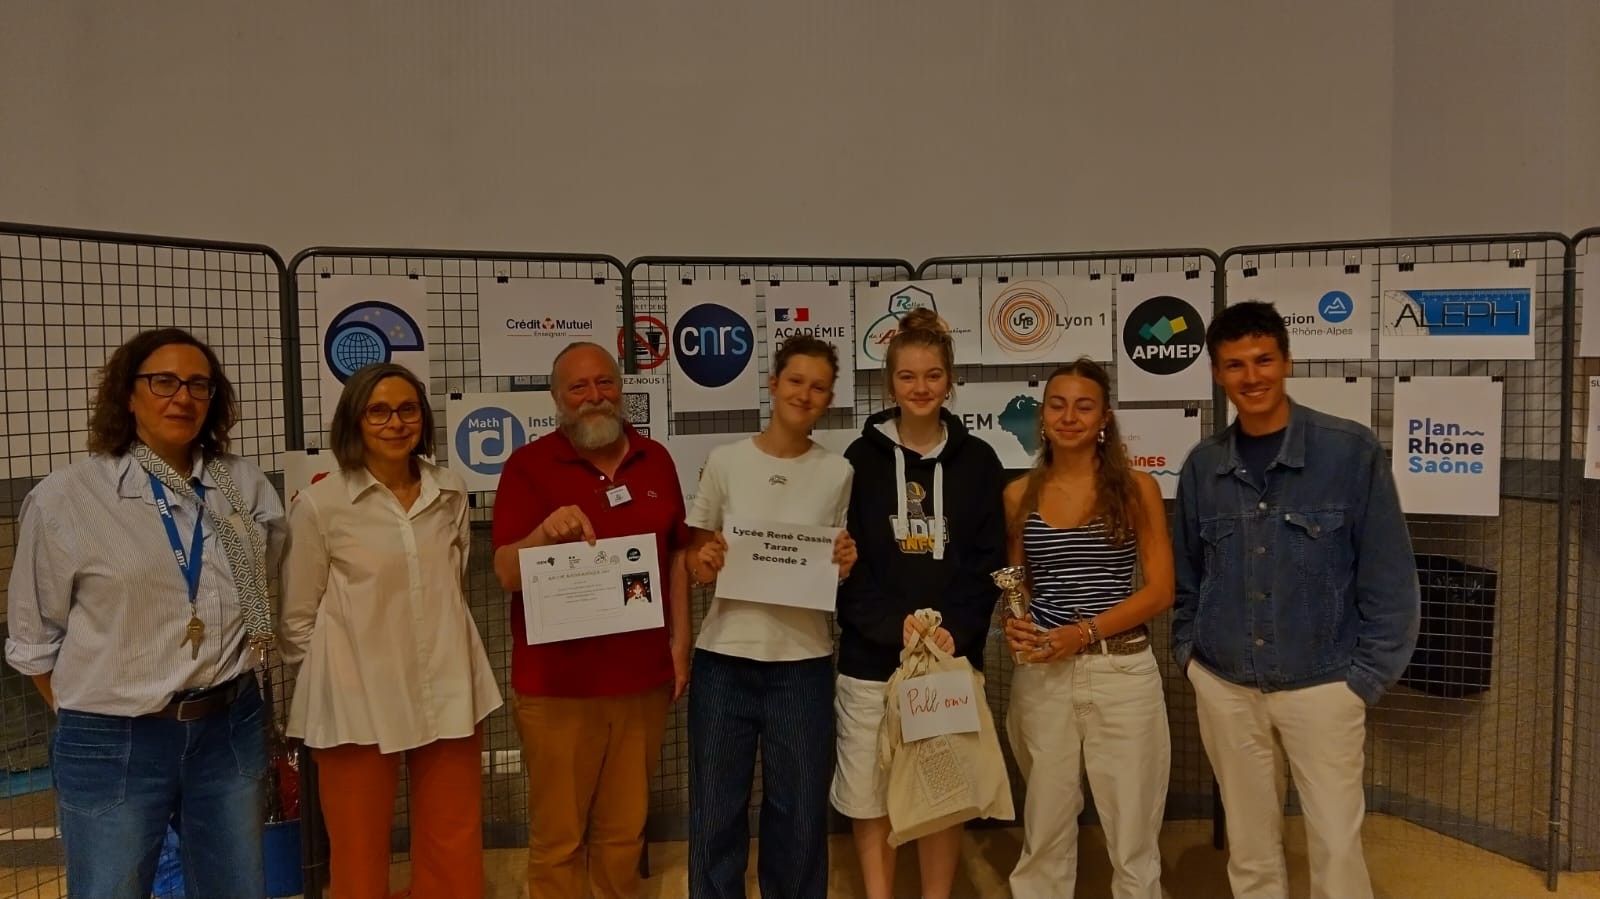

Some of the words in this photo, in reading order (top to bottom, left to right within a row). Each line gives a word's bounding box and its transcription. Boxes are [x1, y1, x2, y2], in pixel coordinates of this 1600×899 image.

[1055, 313, 1093, 330] Lyon
[1099, 313, 1105, 326] 1
[1283, 313, 1315, 326] gion
[1394, 301, 1521, 328] ALEPH
[506, 318, 541, 329] Crédit
[556, 319, 593, 329] Mutuel
[774, 324, 845, 338] ACADÉMIE
[1288, 327, 1353, 336] -Rhône-Alpes
[680, 326, 748, 356] cnrs
[1132, 344, 1201, 360] APMEP
[623, 377, 660, 385] EZ-NOUS
[468, 418, 500, 428] Math
[528, 416, 556, 427] Inst
[962, 413, 993, 430] EM
[1408, 418, 1460, 436] Plan
[1408, 437, 1485, 455] Rhône
[1408, 455, 1484, 474] Saône
[732, 526, 764, 537] Lycée
[766, 531, 794, 540] René
[796, 533, 833, 545] Cassin
[763, 542, 799, 553] Tarare
[752, 553, 798, 565] Seconde
[800, 558, 808, 566] 2
